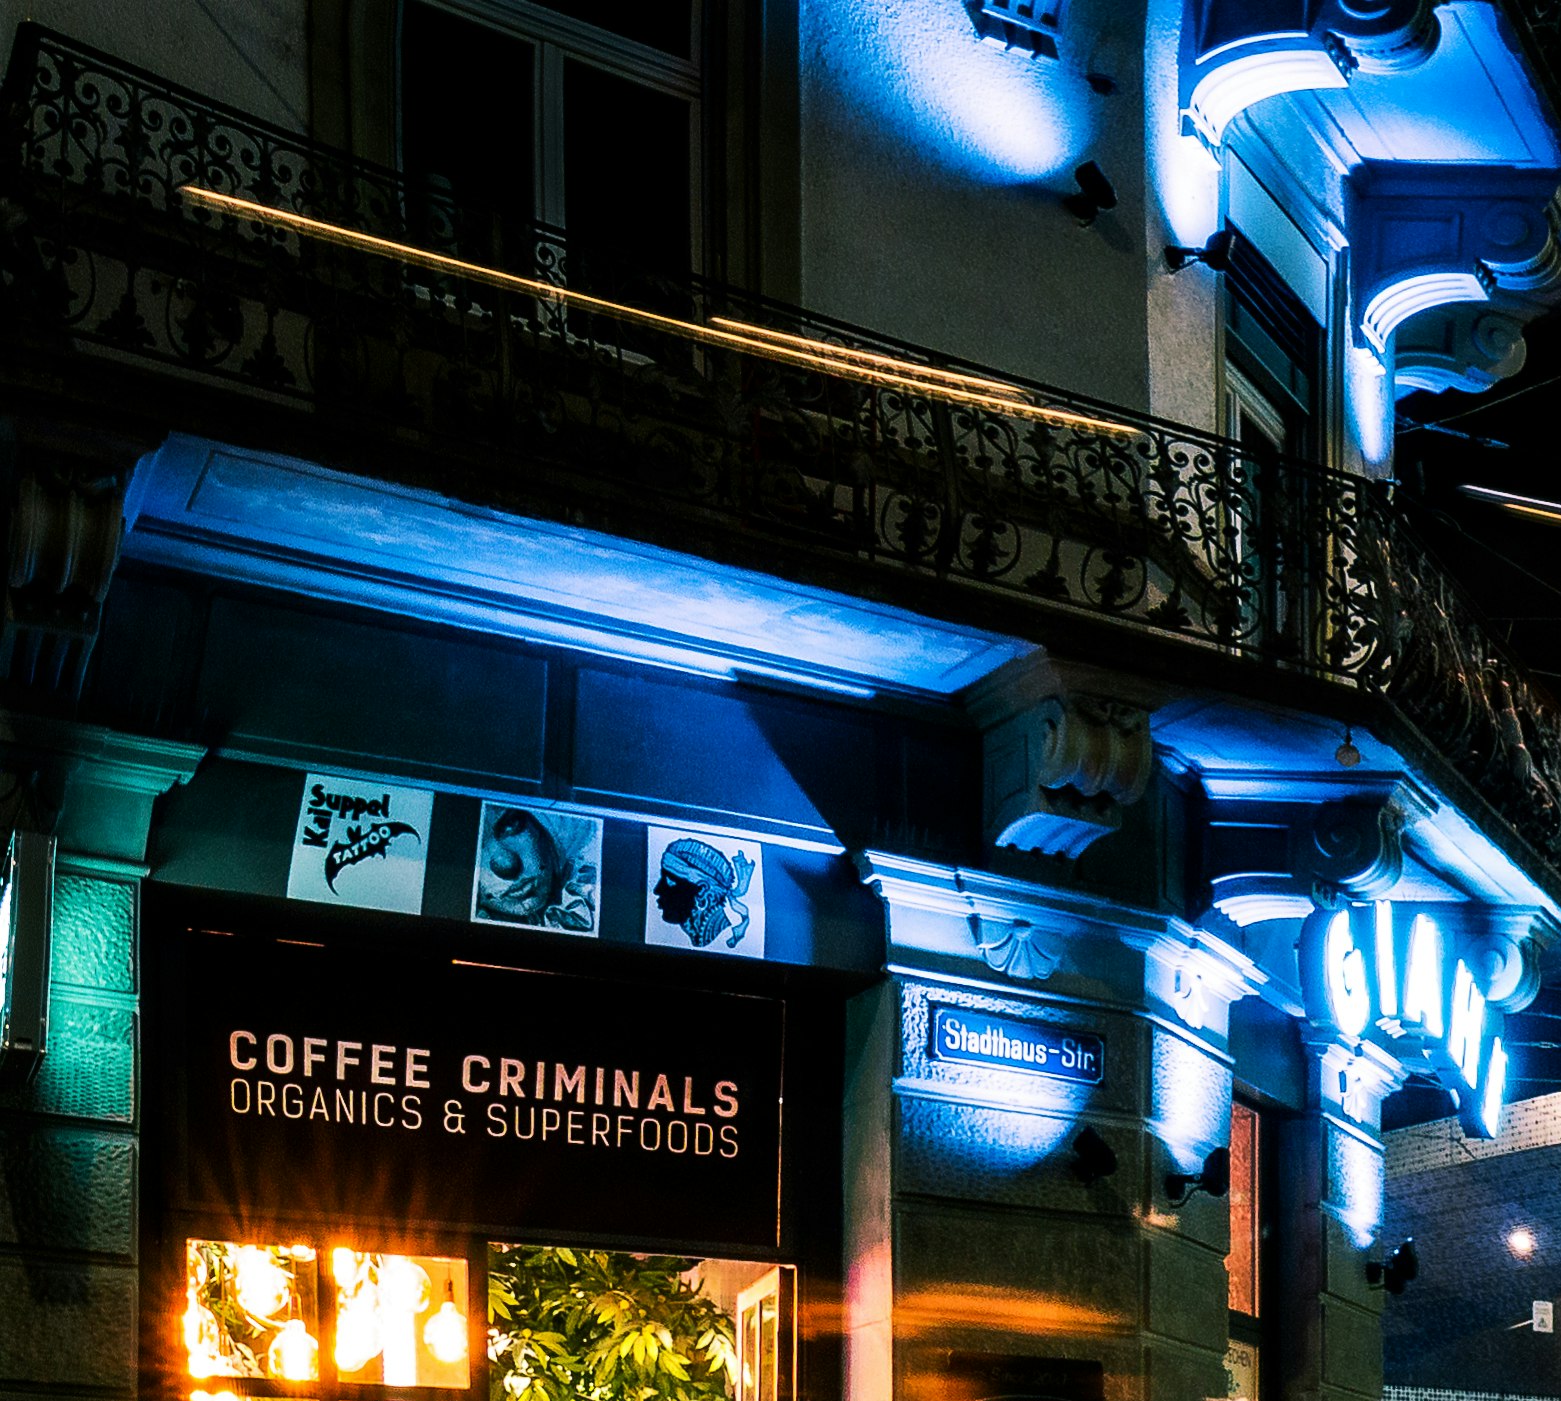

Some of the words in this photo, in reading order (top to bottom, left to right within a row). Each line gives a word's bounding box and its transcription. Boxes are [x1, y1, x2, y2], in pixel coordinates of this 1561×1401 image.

[333, 826, 391, 864] TATTOO
[229, 1030, 431, 1089] COFFEE
[462, 1054, 739, 1118] CRIMINALS
[944, 1018, 1097, 1072] Stadthaus-Str.
[231, 1078, 422, 1130] ORGANICS
[443, 1099, 466, 1134] &
[486, 1103, 739, 1158] SUPERFOODS
